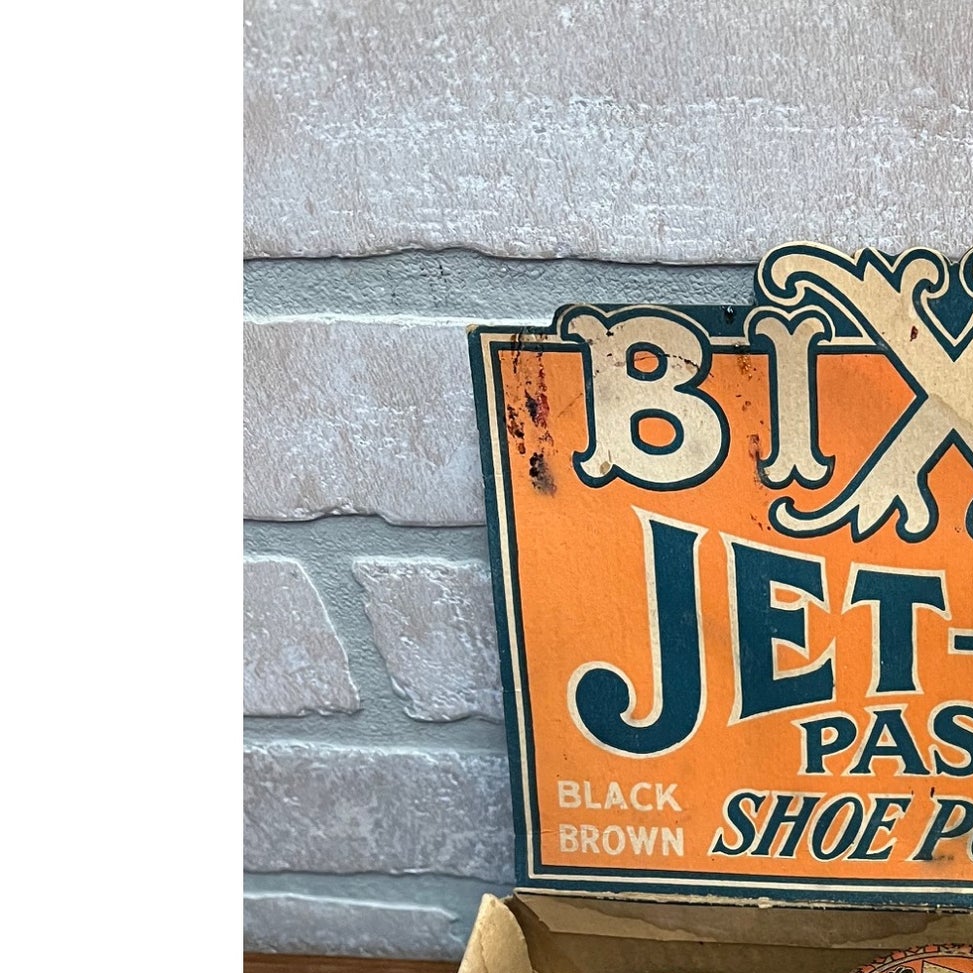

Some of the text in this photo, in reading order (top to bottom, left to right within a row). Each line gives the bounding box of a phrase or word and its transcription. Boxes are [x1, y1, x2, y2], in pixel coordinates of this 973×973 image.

[556, 780, 682, 812] BLACK
[559, 824, 685, 856] BROWN
[708, 788, 914, 861] SHOE
